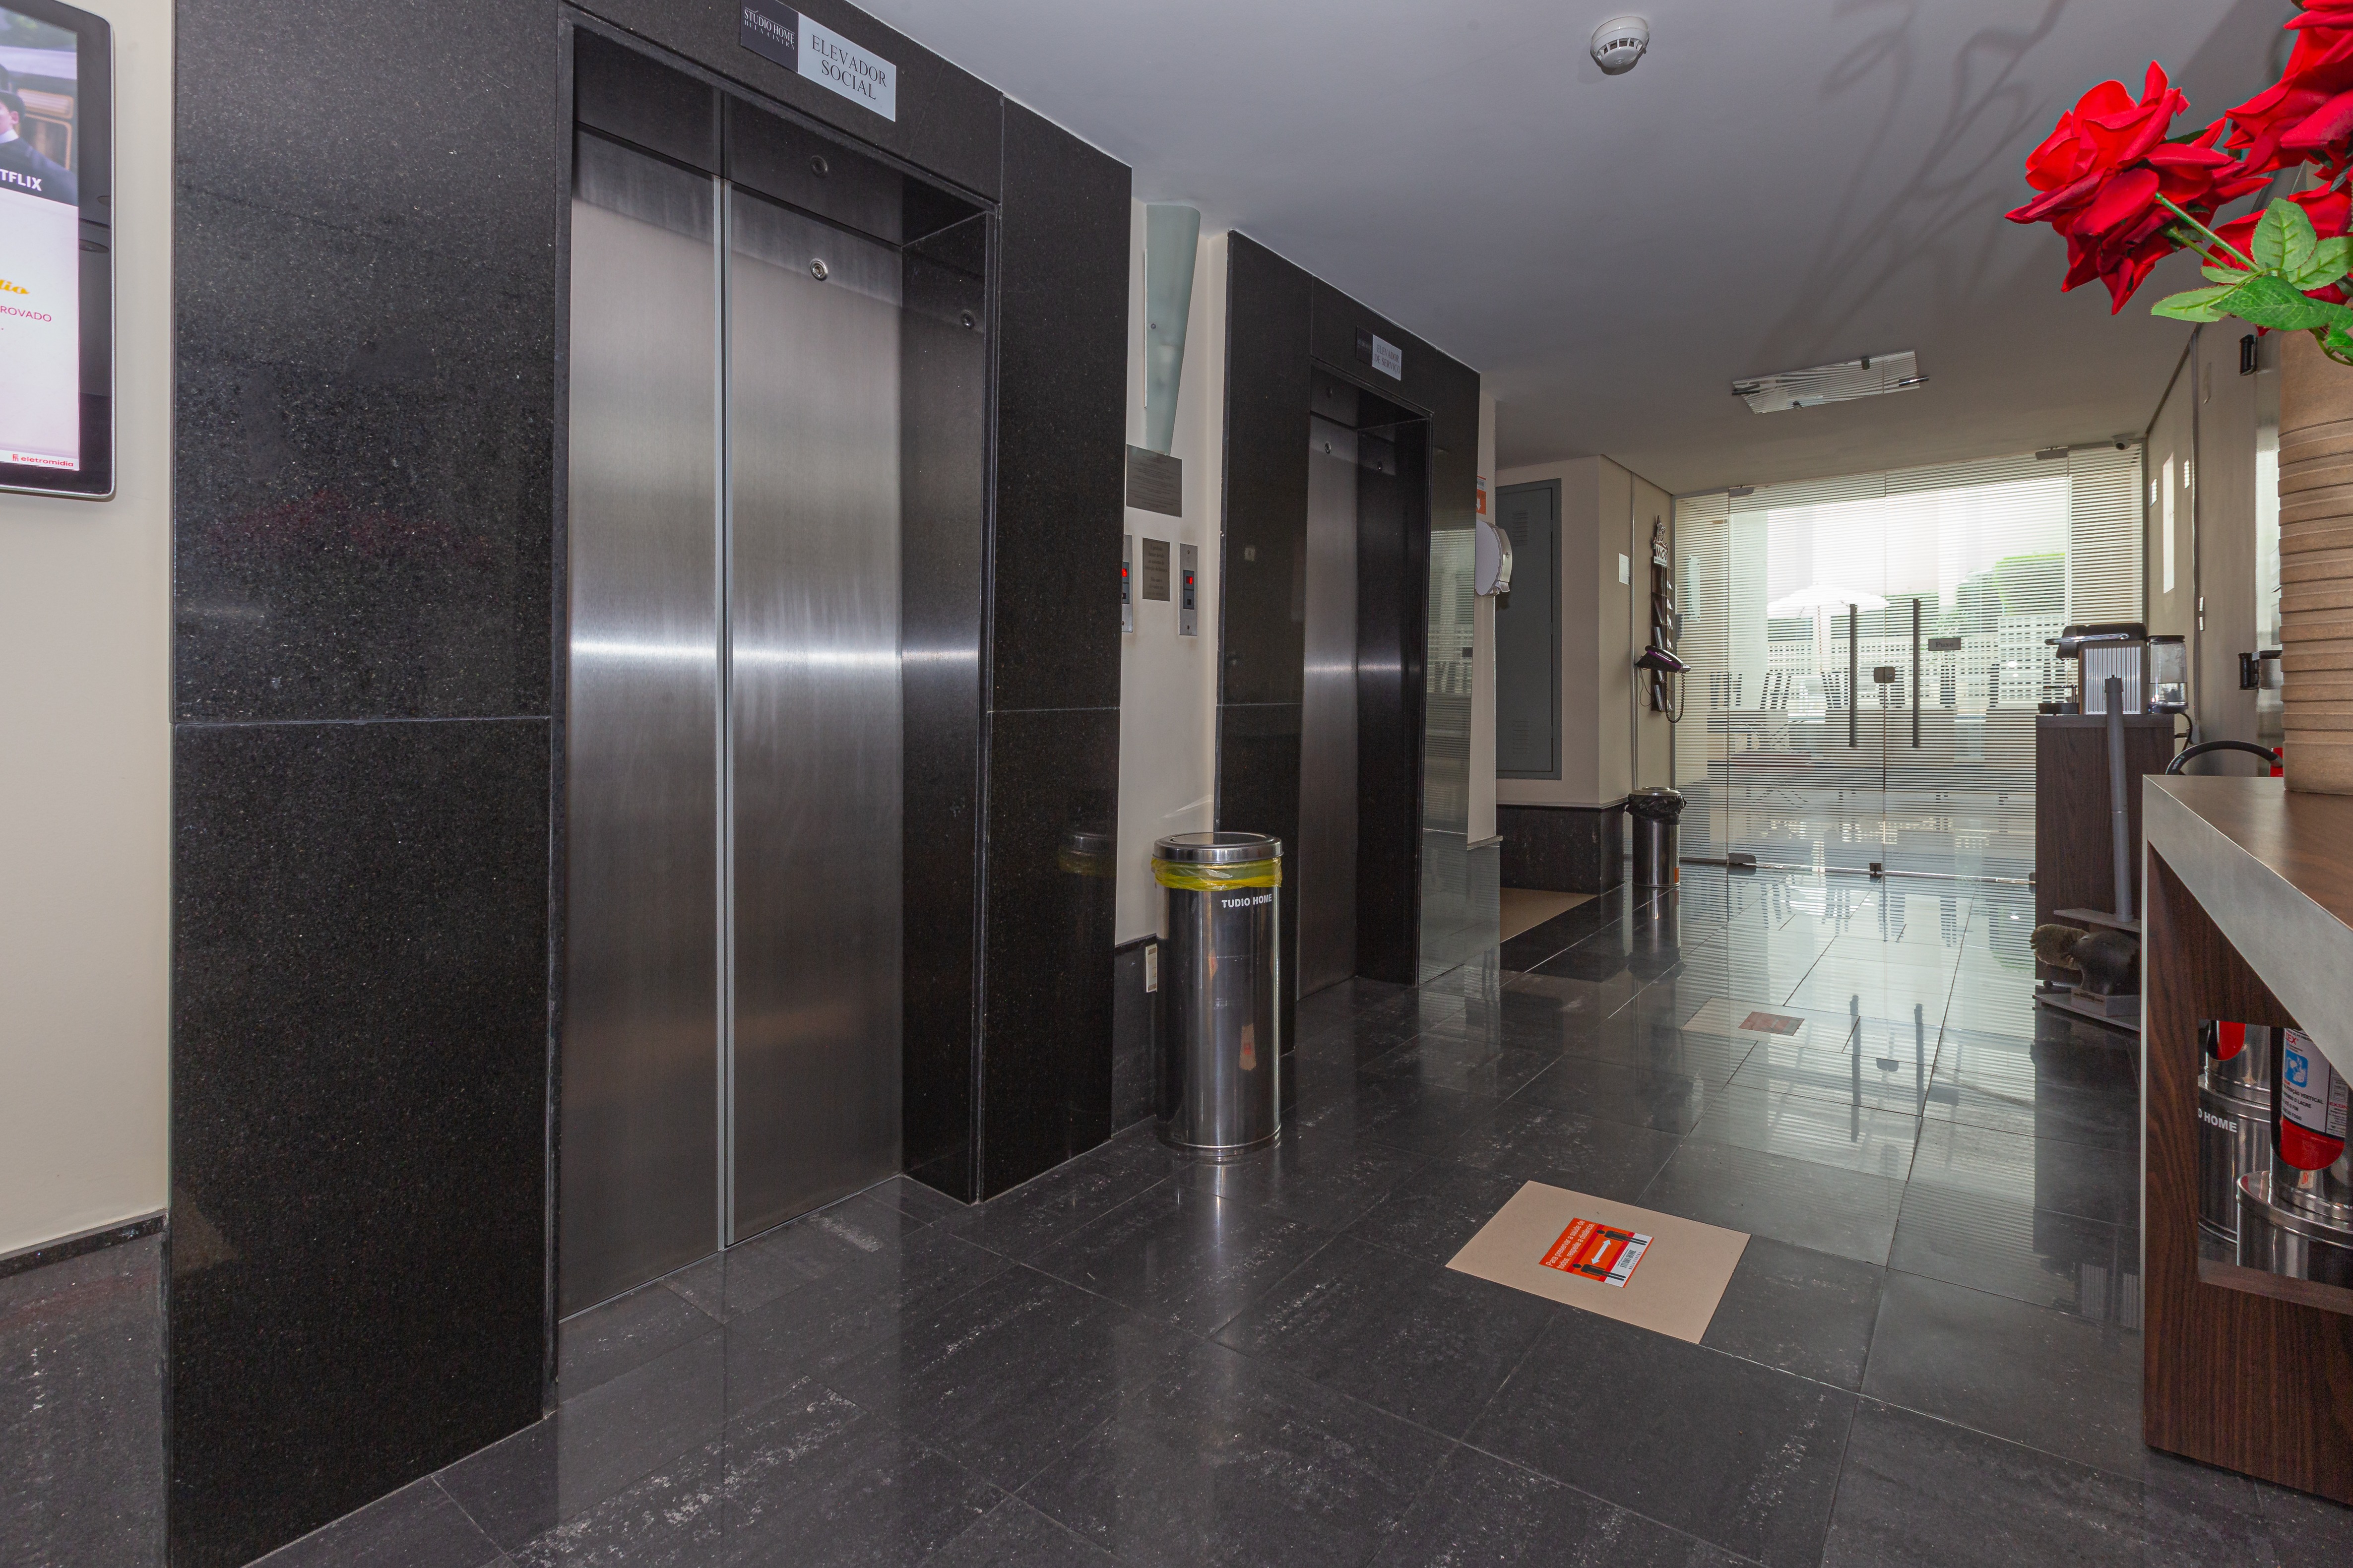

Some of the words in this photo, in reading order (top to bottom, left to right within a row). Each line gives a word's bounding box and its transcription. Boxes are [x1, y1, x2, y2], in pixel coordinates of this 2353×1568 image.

[744, 9, 772, 31] STUDIO
[773, 24, 794, 45] HOME
[812, 34, 887, 87] ELEVADOR
[822, 60, 876, 100] SOCIAL
[0, 305, 52, 322] ROVADO
[1374, 353, 1381, 364] DE
[1381, 357, 1401, 374] SERVIÇO
[1377, 344, 1399, 363] ELEVADOR
[21, 456, 74, 467] eletromidia
[1221, 897, 1250, 908] TUDIO
[1253, 893, 1272, 905] HOME
[2300, 1092, 2323, 1104] VERTICAL
[2204, 1111, 2237, 1133] HOME
[1545, 1256, 1558, 1266] Para
[1555, 1239, 1571, 1257] preservar
[1570, 1225, 1582, 1237] saúde
[1567, 1242, 1581, 1257] respeite
